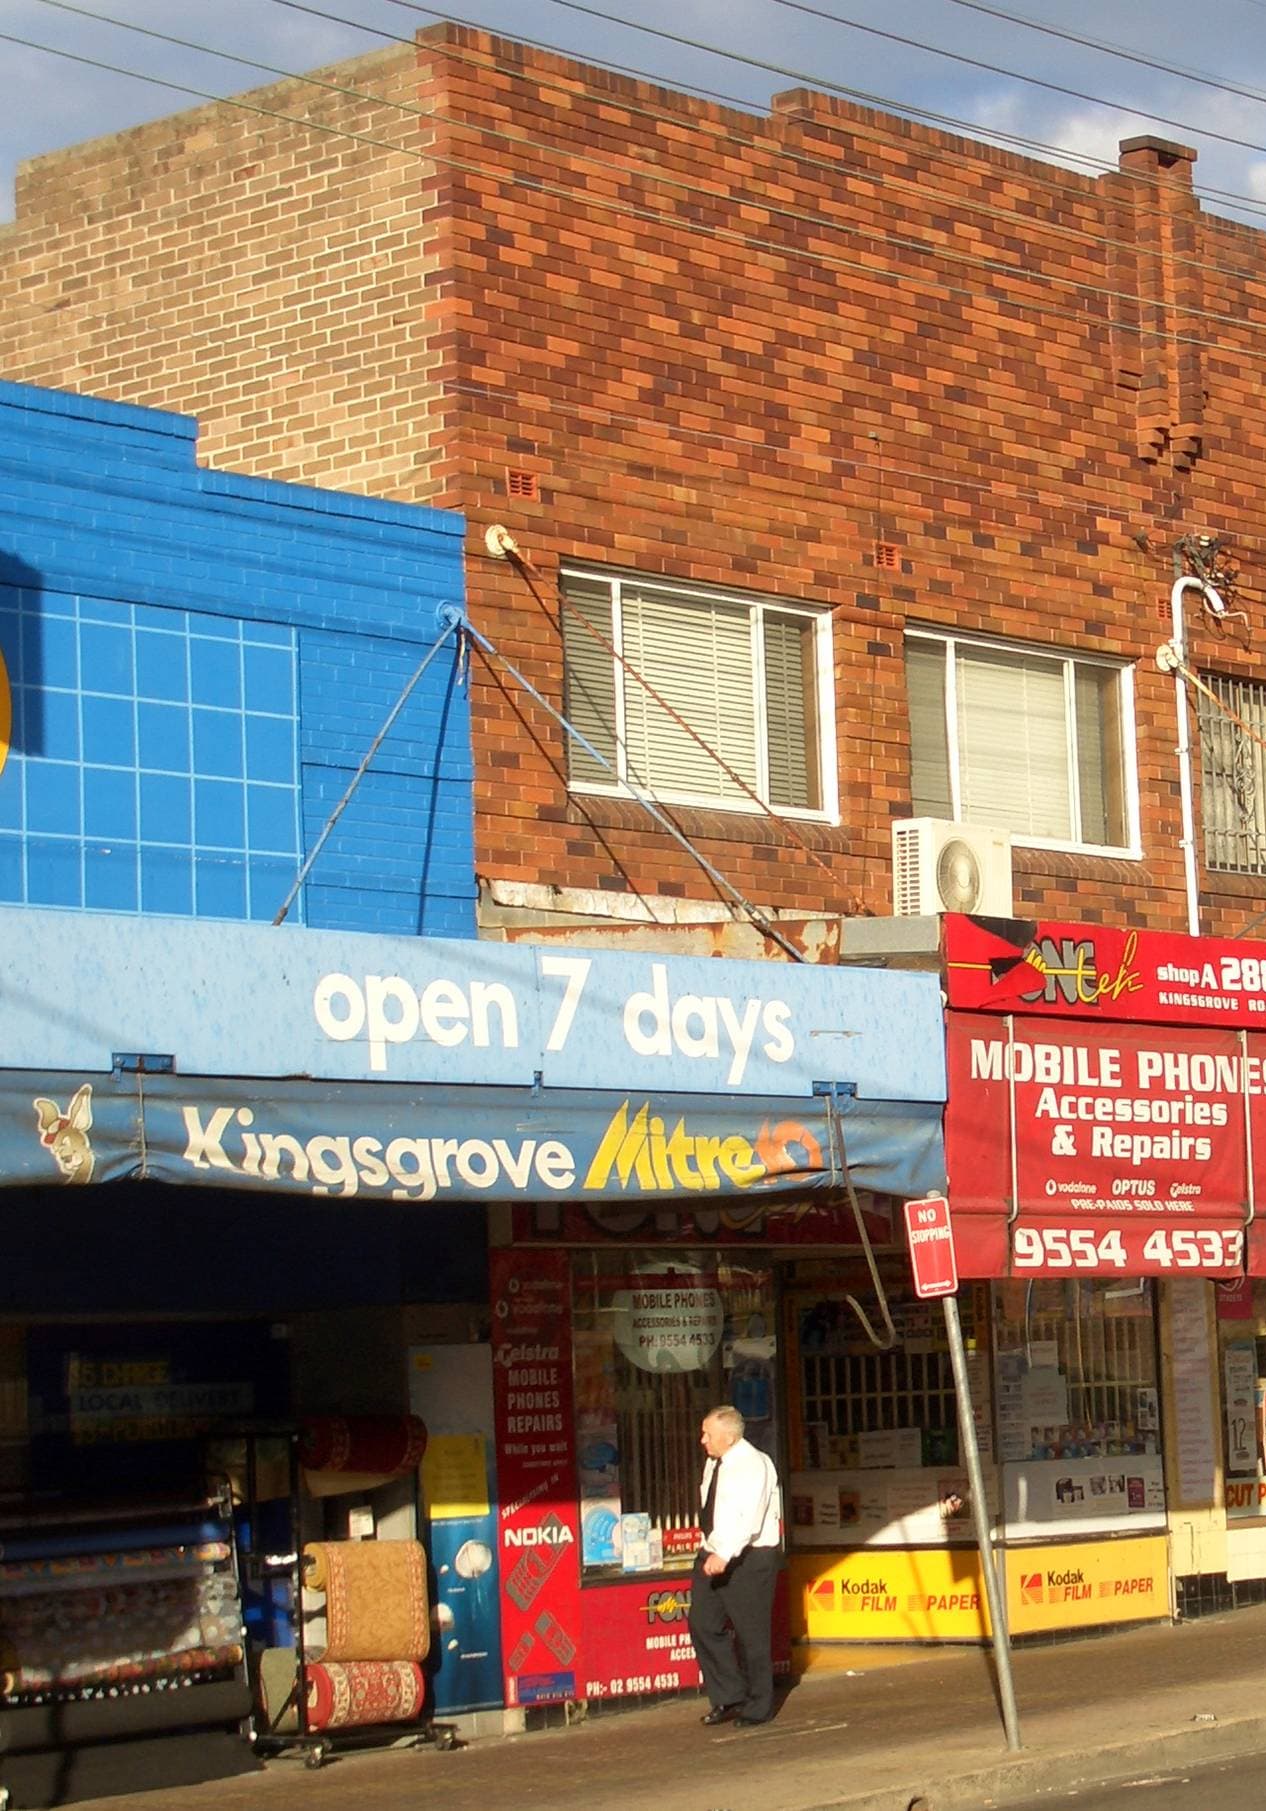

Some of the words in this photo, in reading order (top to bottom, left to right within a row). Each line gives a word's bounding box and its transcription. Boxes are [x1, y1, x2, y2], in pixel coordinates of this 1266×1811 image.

[1157, 963, 1200, 987] shop
[1200, 963, 1219, 990] A
[1158, 991, 1239, 1011] KINGSGROVE
[313, 972, 518, 1070] open
[541, 955, 592, 1051] 7
[623, 963, 795, 1086] days
[970, 1038, 1122, 1088] MOBILE
[1035, 1087, 1228, 1126] Accessories
[181, 1107, 576, 1200] Kingsgrove
[582, 1099, 768, 1190] Mitre
[754, 1117, 824, 1185] 10
[1051, 1124, 1077, 1157] &
[1092, 1125, 1213, 1166] Repairs
[1057, 1181, 1098, 1194] vodafone
[1112, 1179, 1156, 1196] OPTUS
[1169, 1182, 1202, 1199] Telstra
[1071, 1198, 1134, 1212] PRE-PAIDS
[1134, 1199, 1165, 1212] SOLD
[1165, 1200, 1196, 1212] HERE
[917, 1208, 937, 1224] NO
[911, 1226, 951, 1244] STOPPING
[1013, 1228, 1128, 1268] 9554
[1142, 1229, 1244, 1268] 4533
[633, 1293, 673, 1309] MOBILE
[508, 1368, 558, 1387] MOBILE
[507, 1390, 561, 1410] PHONES
[507, 1413, 564, 1434] REPAIRS
[1226, 1482, 1254, 1508] CUT
[504, 1524, 574, 1547] NOKIA
[841, 1578, 888, 1595] Kodak
[1047, 1567, 1085, 1586] Kodak
[1063, 1583, 1092, 1600] FILM
[1113, 1577, 1154, 1595] PAPER
[860, 1595, 897, 1612] FILM
[926, 1594, 980, 1611] PAPER
[646, 1634, 677, 1650] MOBILE
[610, 1678, 624, 1694] 02
[625, 1675, 652, 1693] 9554
[654, 1671, 680, 1689] 4533
